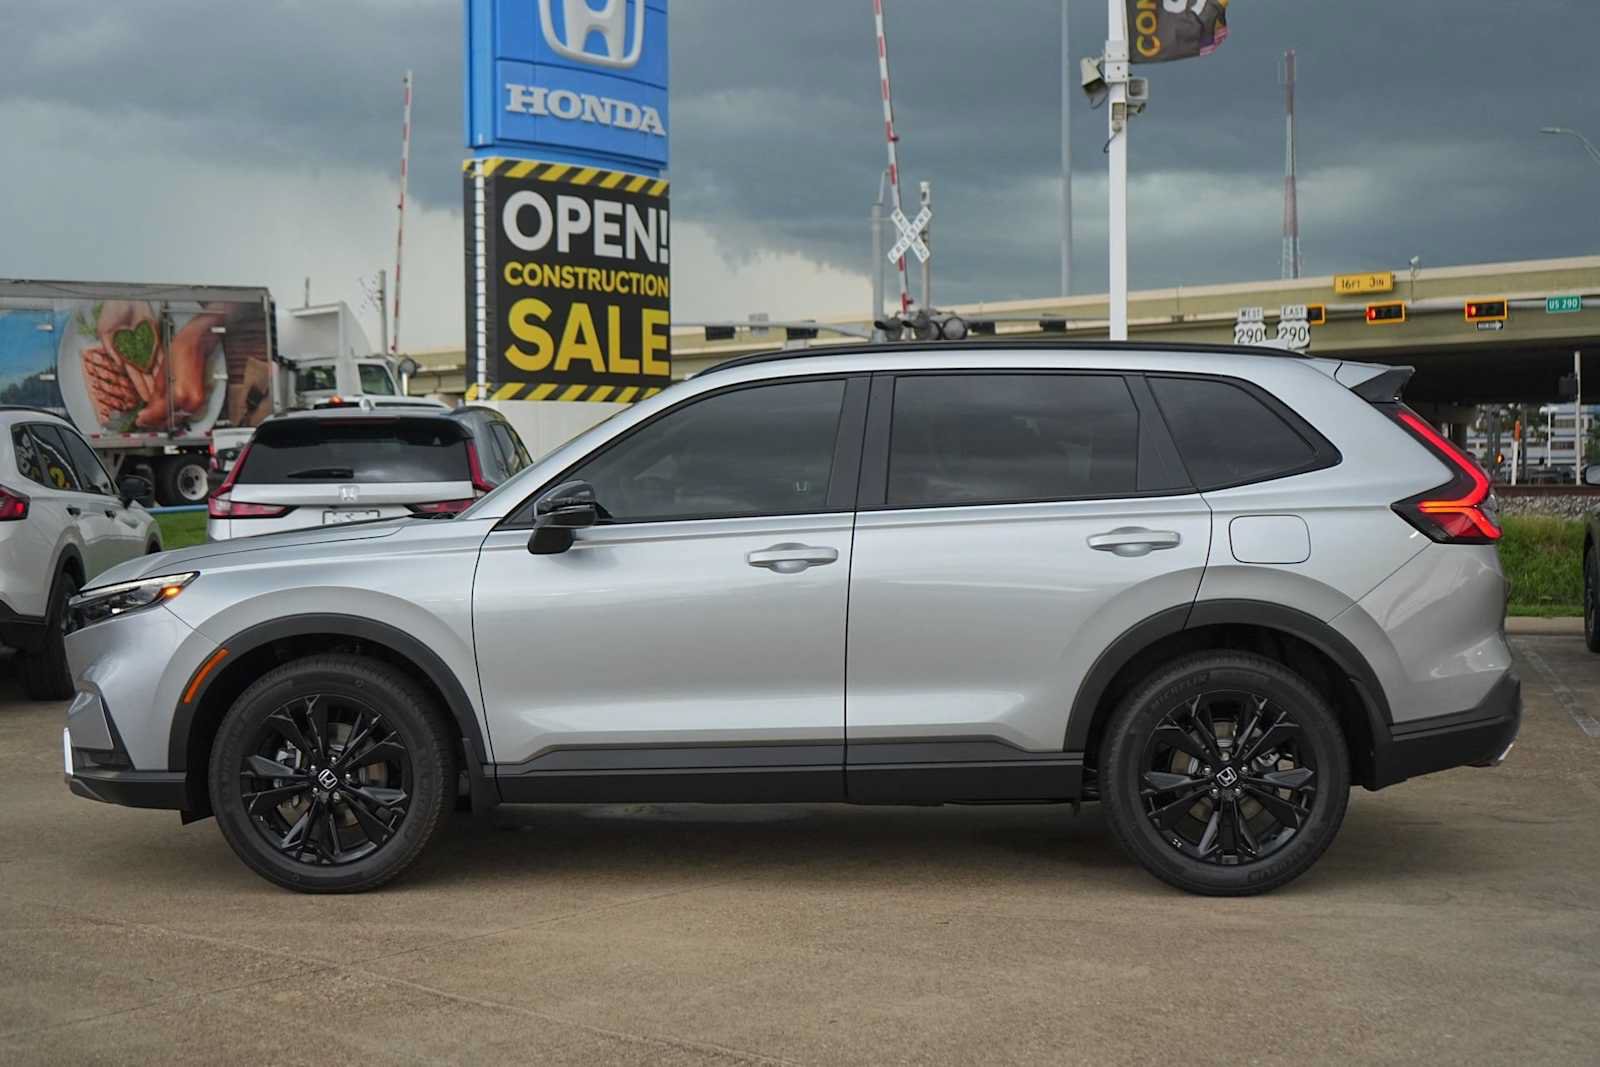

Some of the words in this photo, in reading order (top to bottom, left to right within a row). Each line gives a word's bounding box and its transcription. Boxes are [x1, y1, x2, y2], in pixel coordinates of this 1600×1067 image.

[505, 83, 667, 136] HONDA
[502, 190, 669, 264] OPEN!
[504, 261, 669, 298] CONSTRUCTION
[1549, 301, 1559, 310] US
[1561, 299, 1578, 309] 290
[504, 298, 670, 376] SALE
[1237, 327, 1263, 344] 290
[1281, 326, 1306, 342] 290
